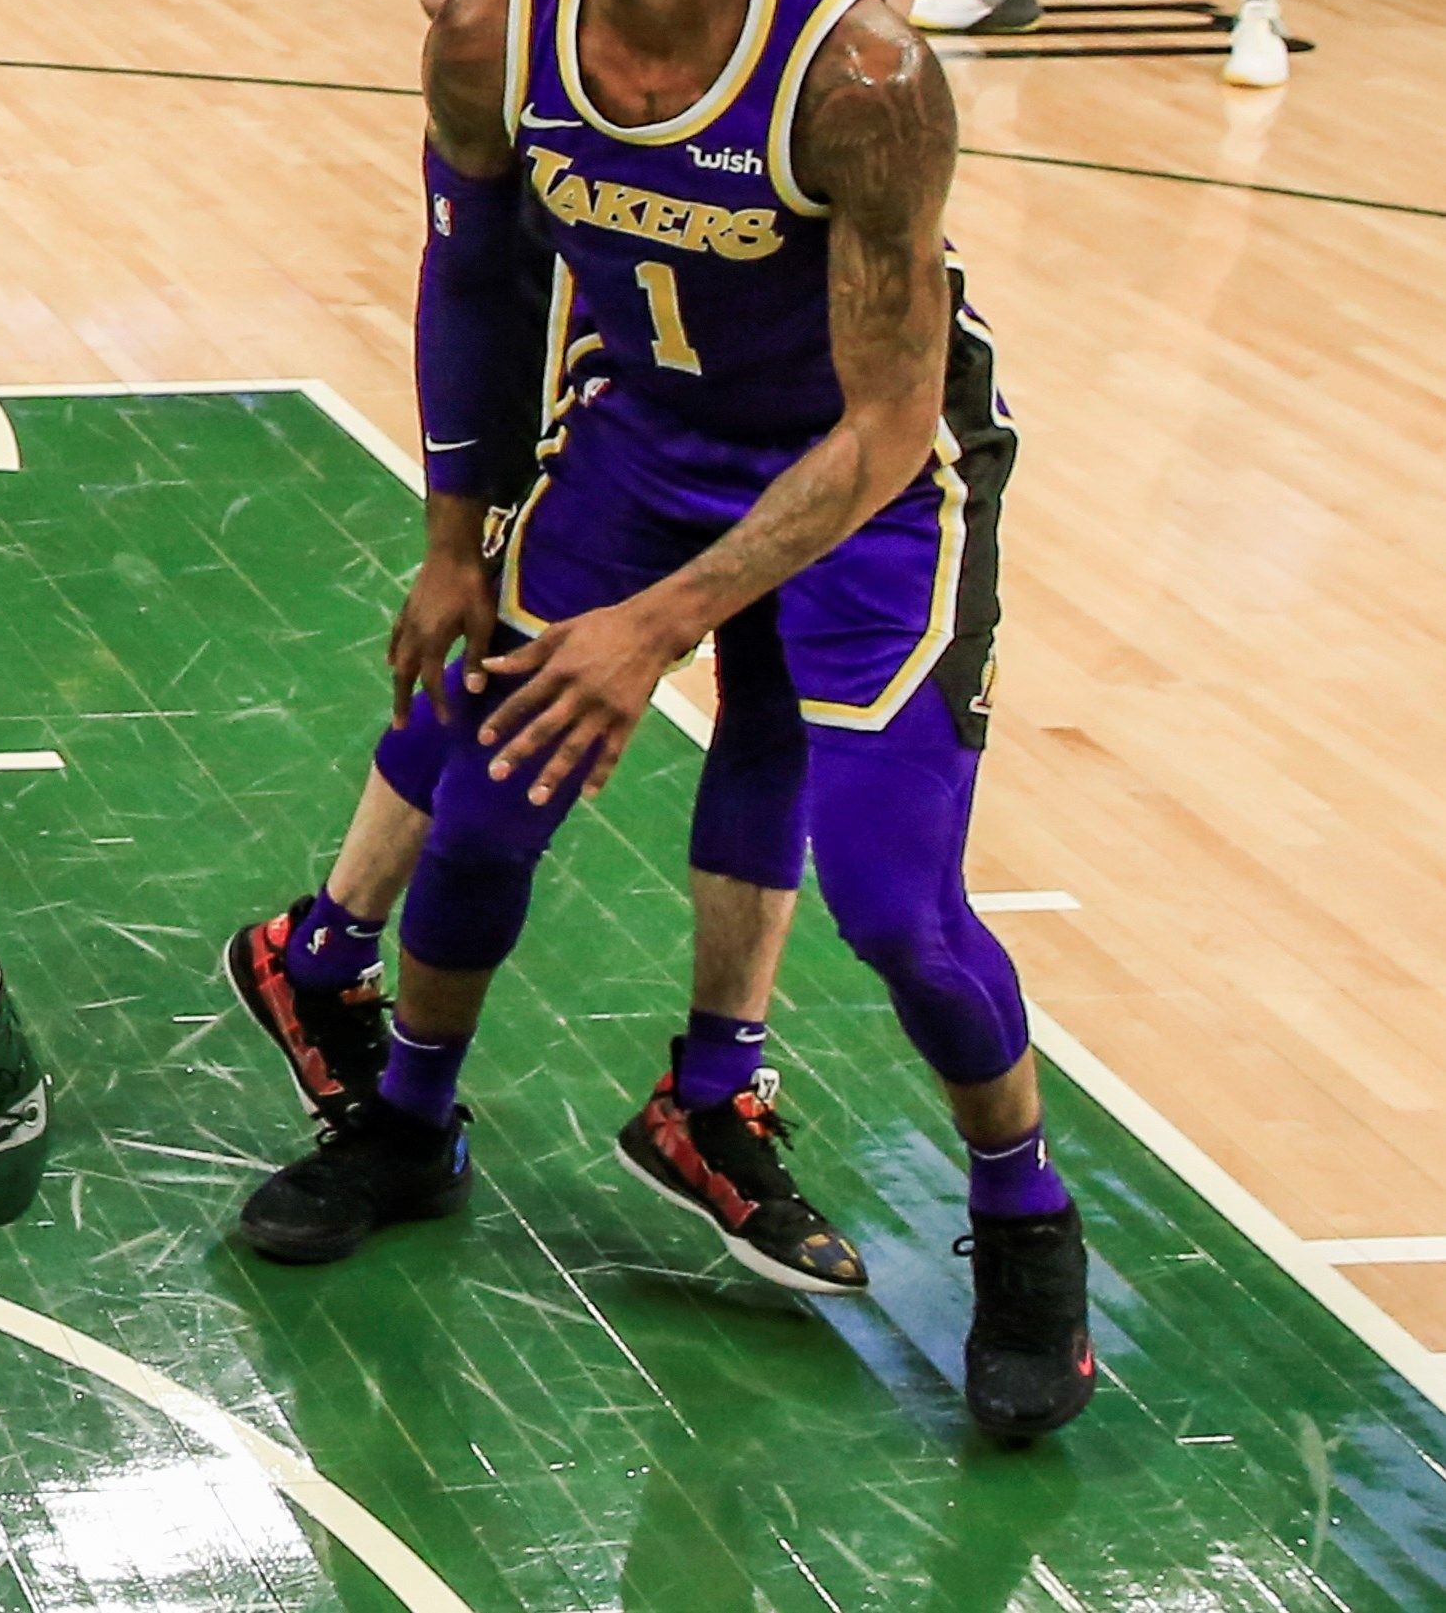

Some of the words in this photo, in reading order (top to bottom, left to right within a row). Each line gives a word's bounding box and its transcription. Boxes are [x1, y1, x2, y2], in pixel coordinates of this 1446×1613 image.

[526, 145, 786, 261] LAKERS
[685, 143, 764, 177] wish
[634, 260, 703, 377] 1
